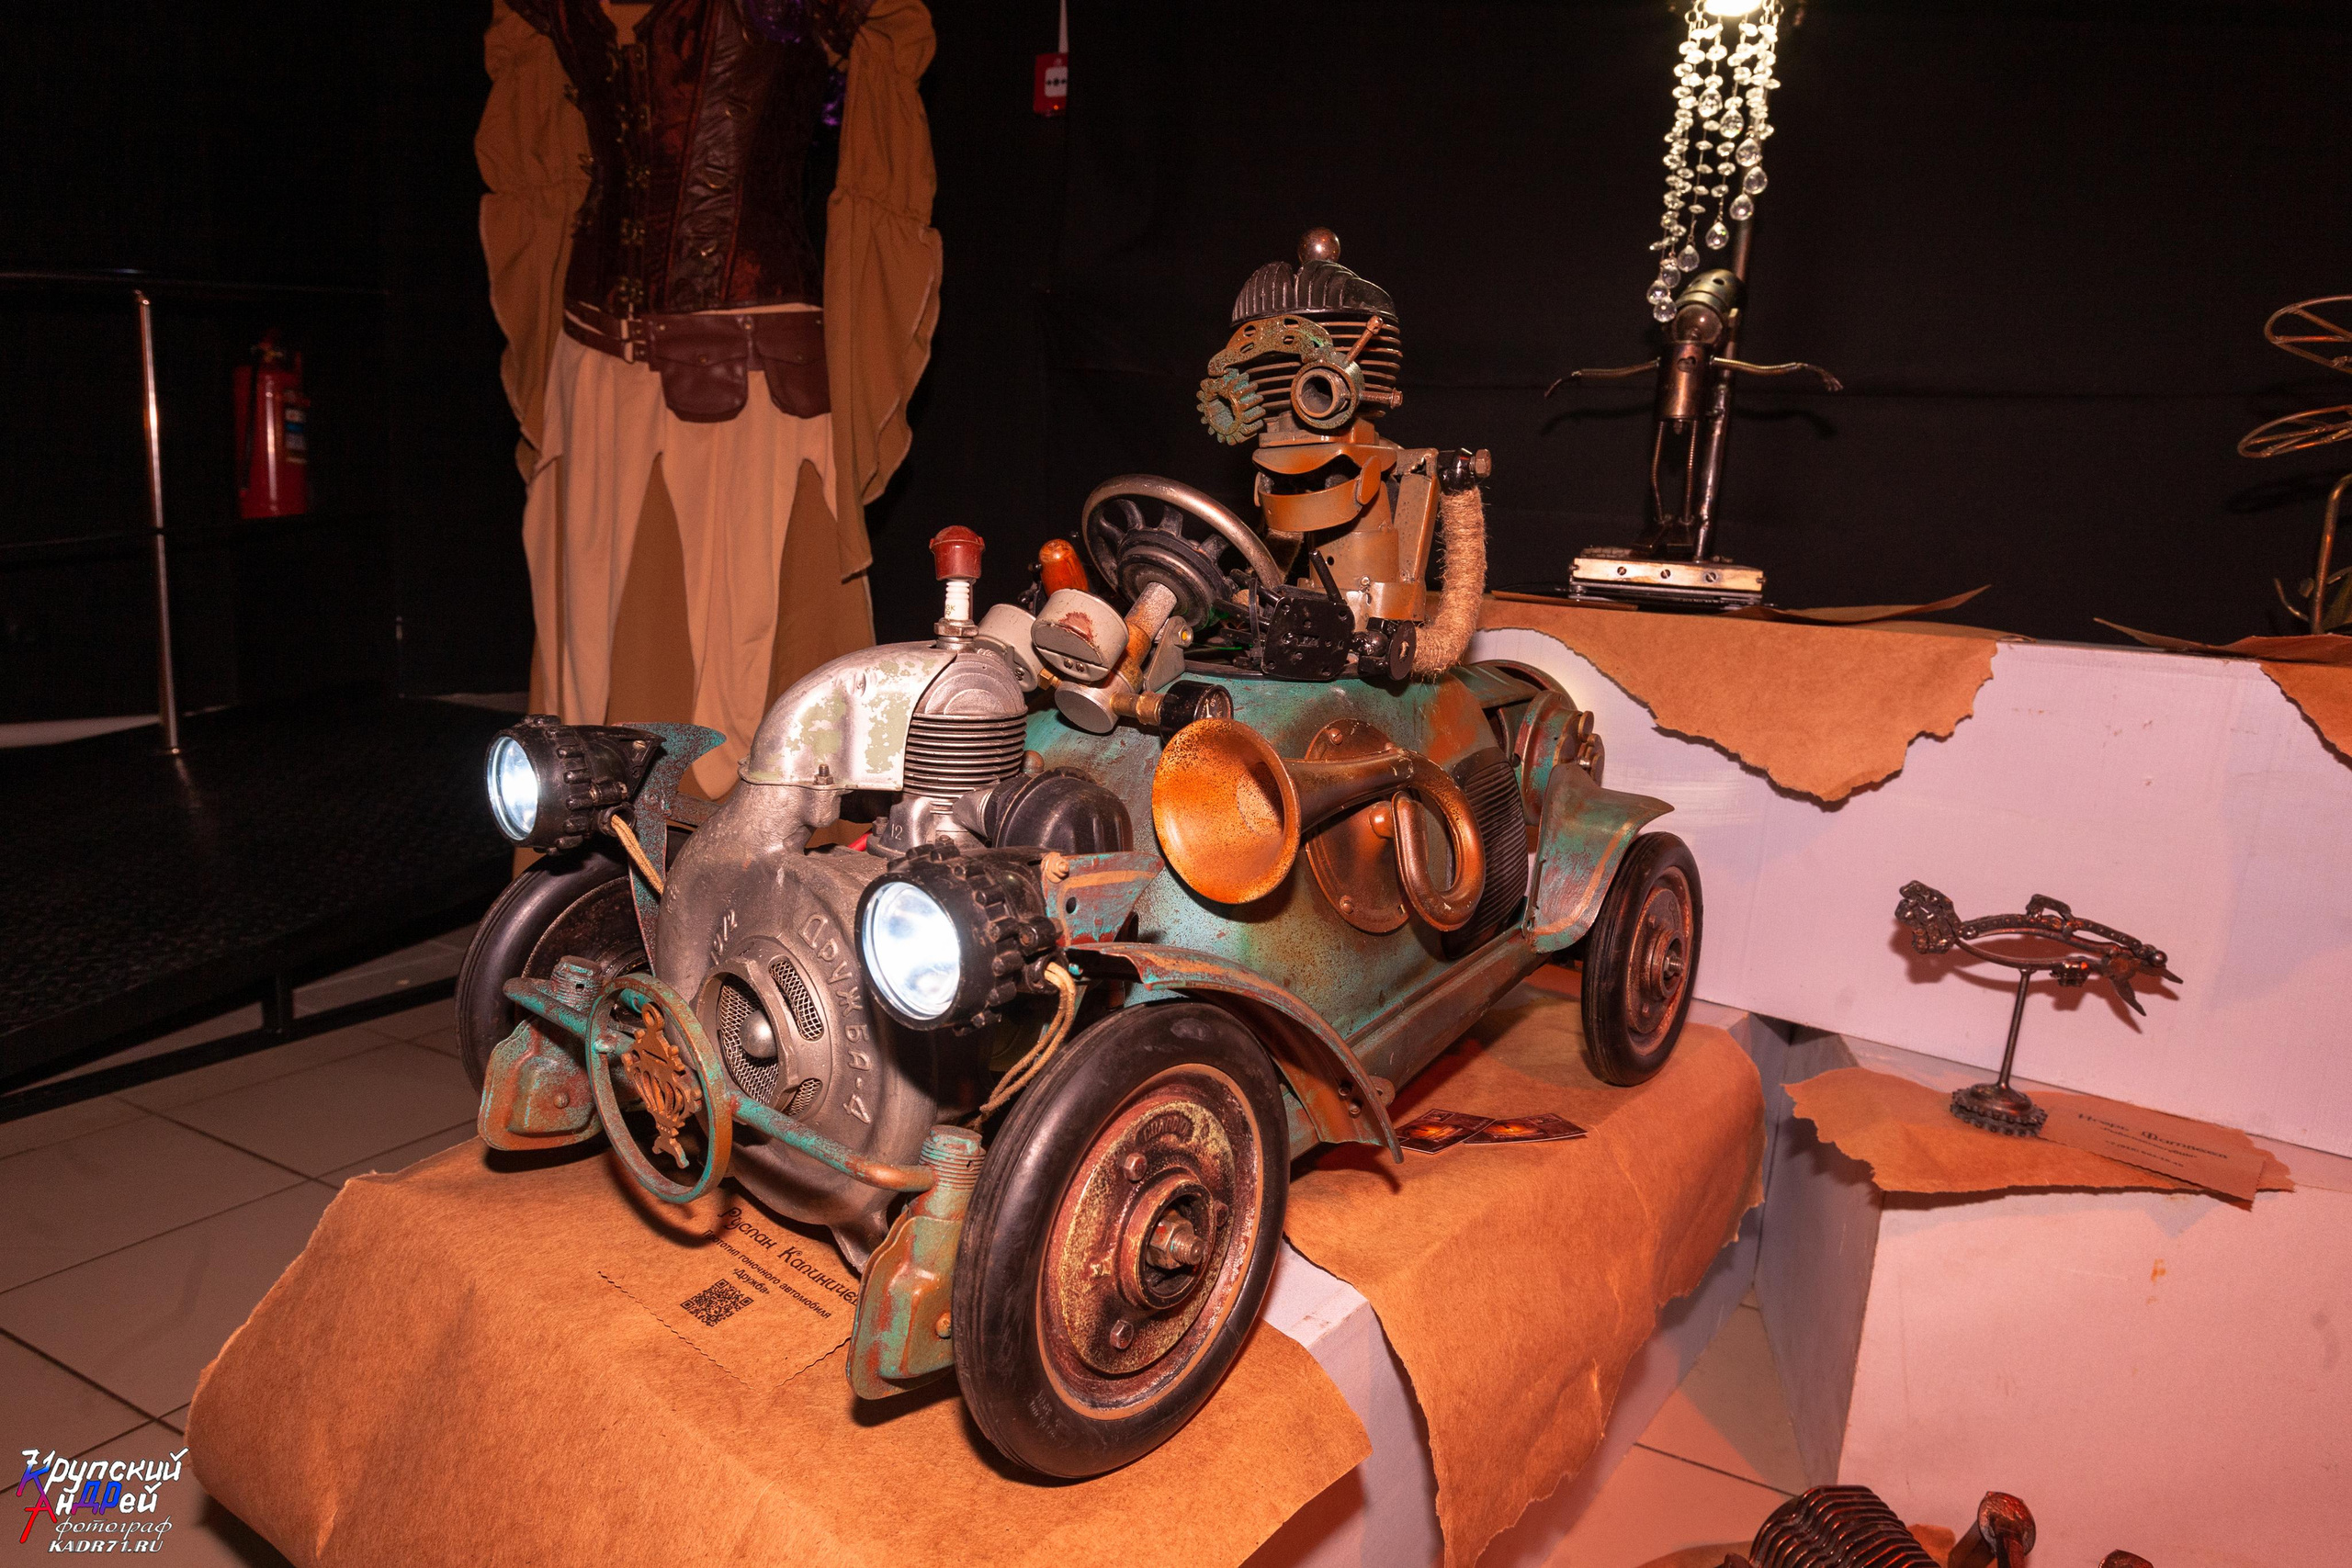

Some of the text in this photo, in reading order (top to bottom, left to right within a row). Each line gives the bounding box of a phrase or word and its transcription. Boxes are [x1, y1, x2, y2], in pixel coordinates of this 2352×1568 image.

[891, 823, 903, 840] 12
[718, 1207, 776, 1249] Руслан
[702, 1229, 831, 1319] Прототип гоночного автомобиля
